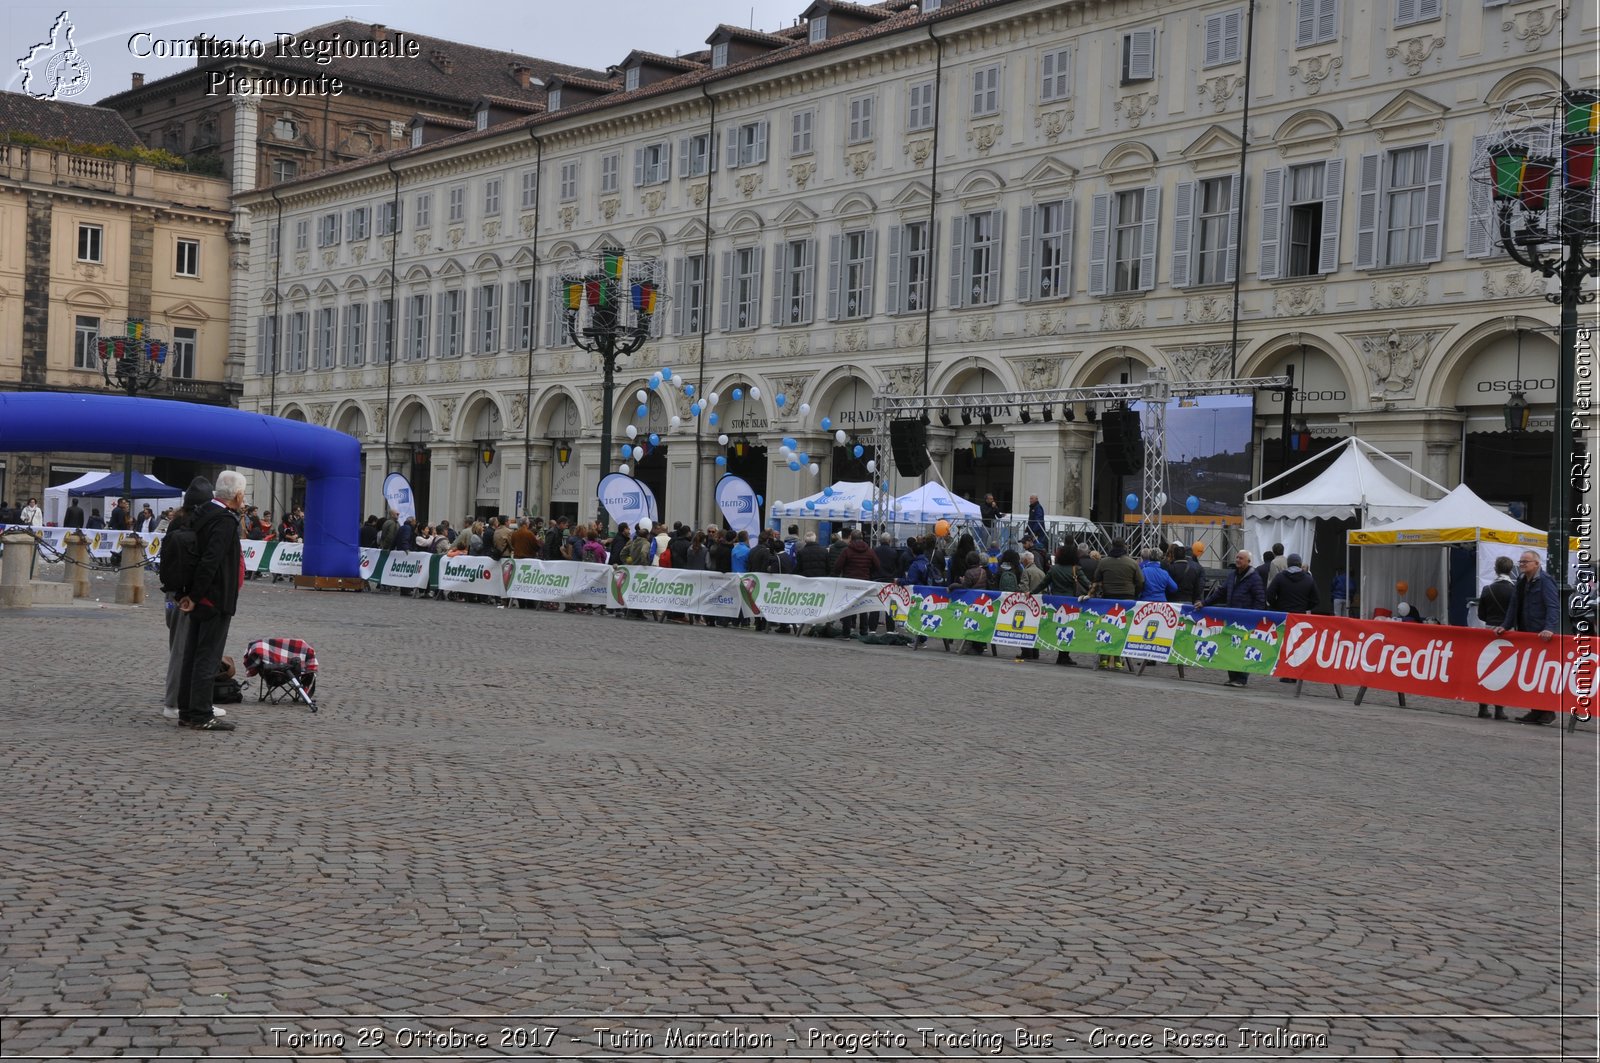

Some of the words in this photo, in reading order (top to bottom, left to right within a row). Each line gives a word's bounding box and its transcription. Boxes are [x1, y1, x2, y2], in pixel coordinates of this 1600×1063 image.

[731, 419, 750, 429] STONE
[390, 558, 422, 578] battaglio
[444, 561, 491, 583] battaglio
[517, 564, 570, 588] Tailorsan
[632, 572, 694, 597] Tailorsan
[763, 581, 827, 608] Tailorsan
[1135, 602, 1176, 627] TAPPOROSSO
[1315, 627, 1454, 683] UniCredit
